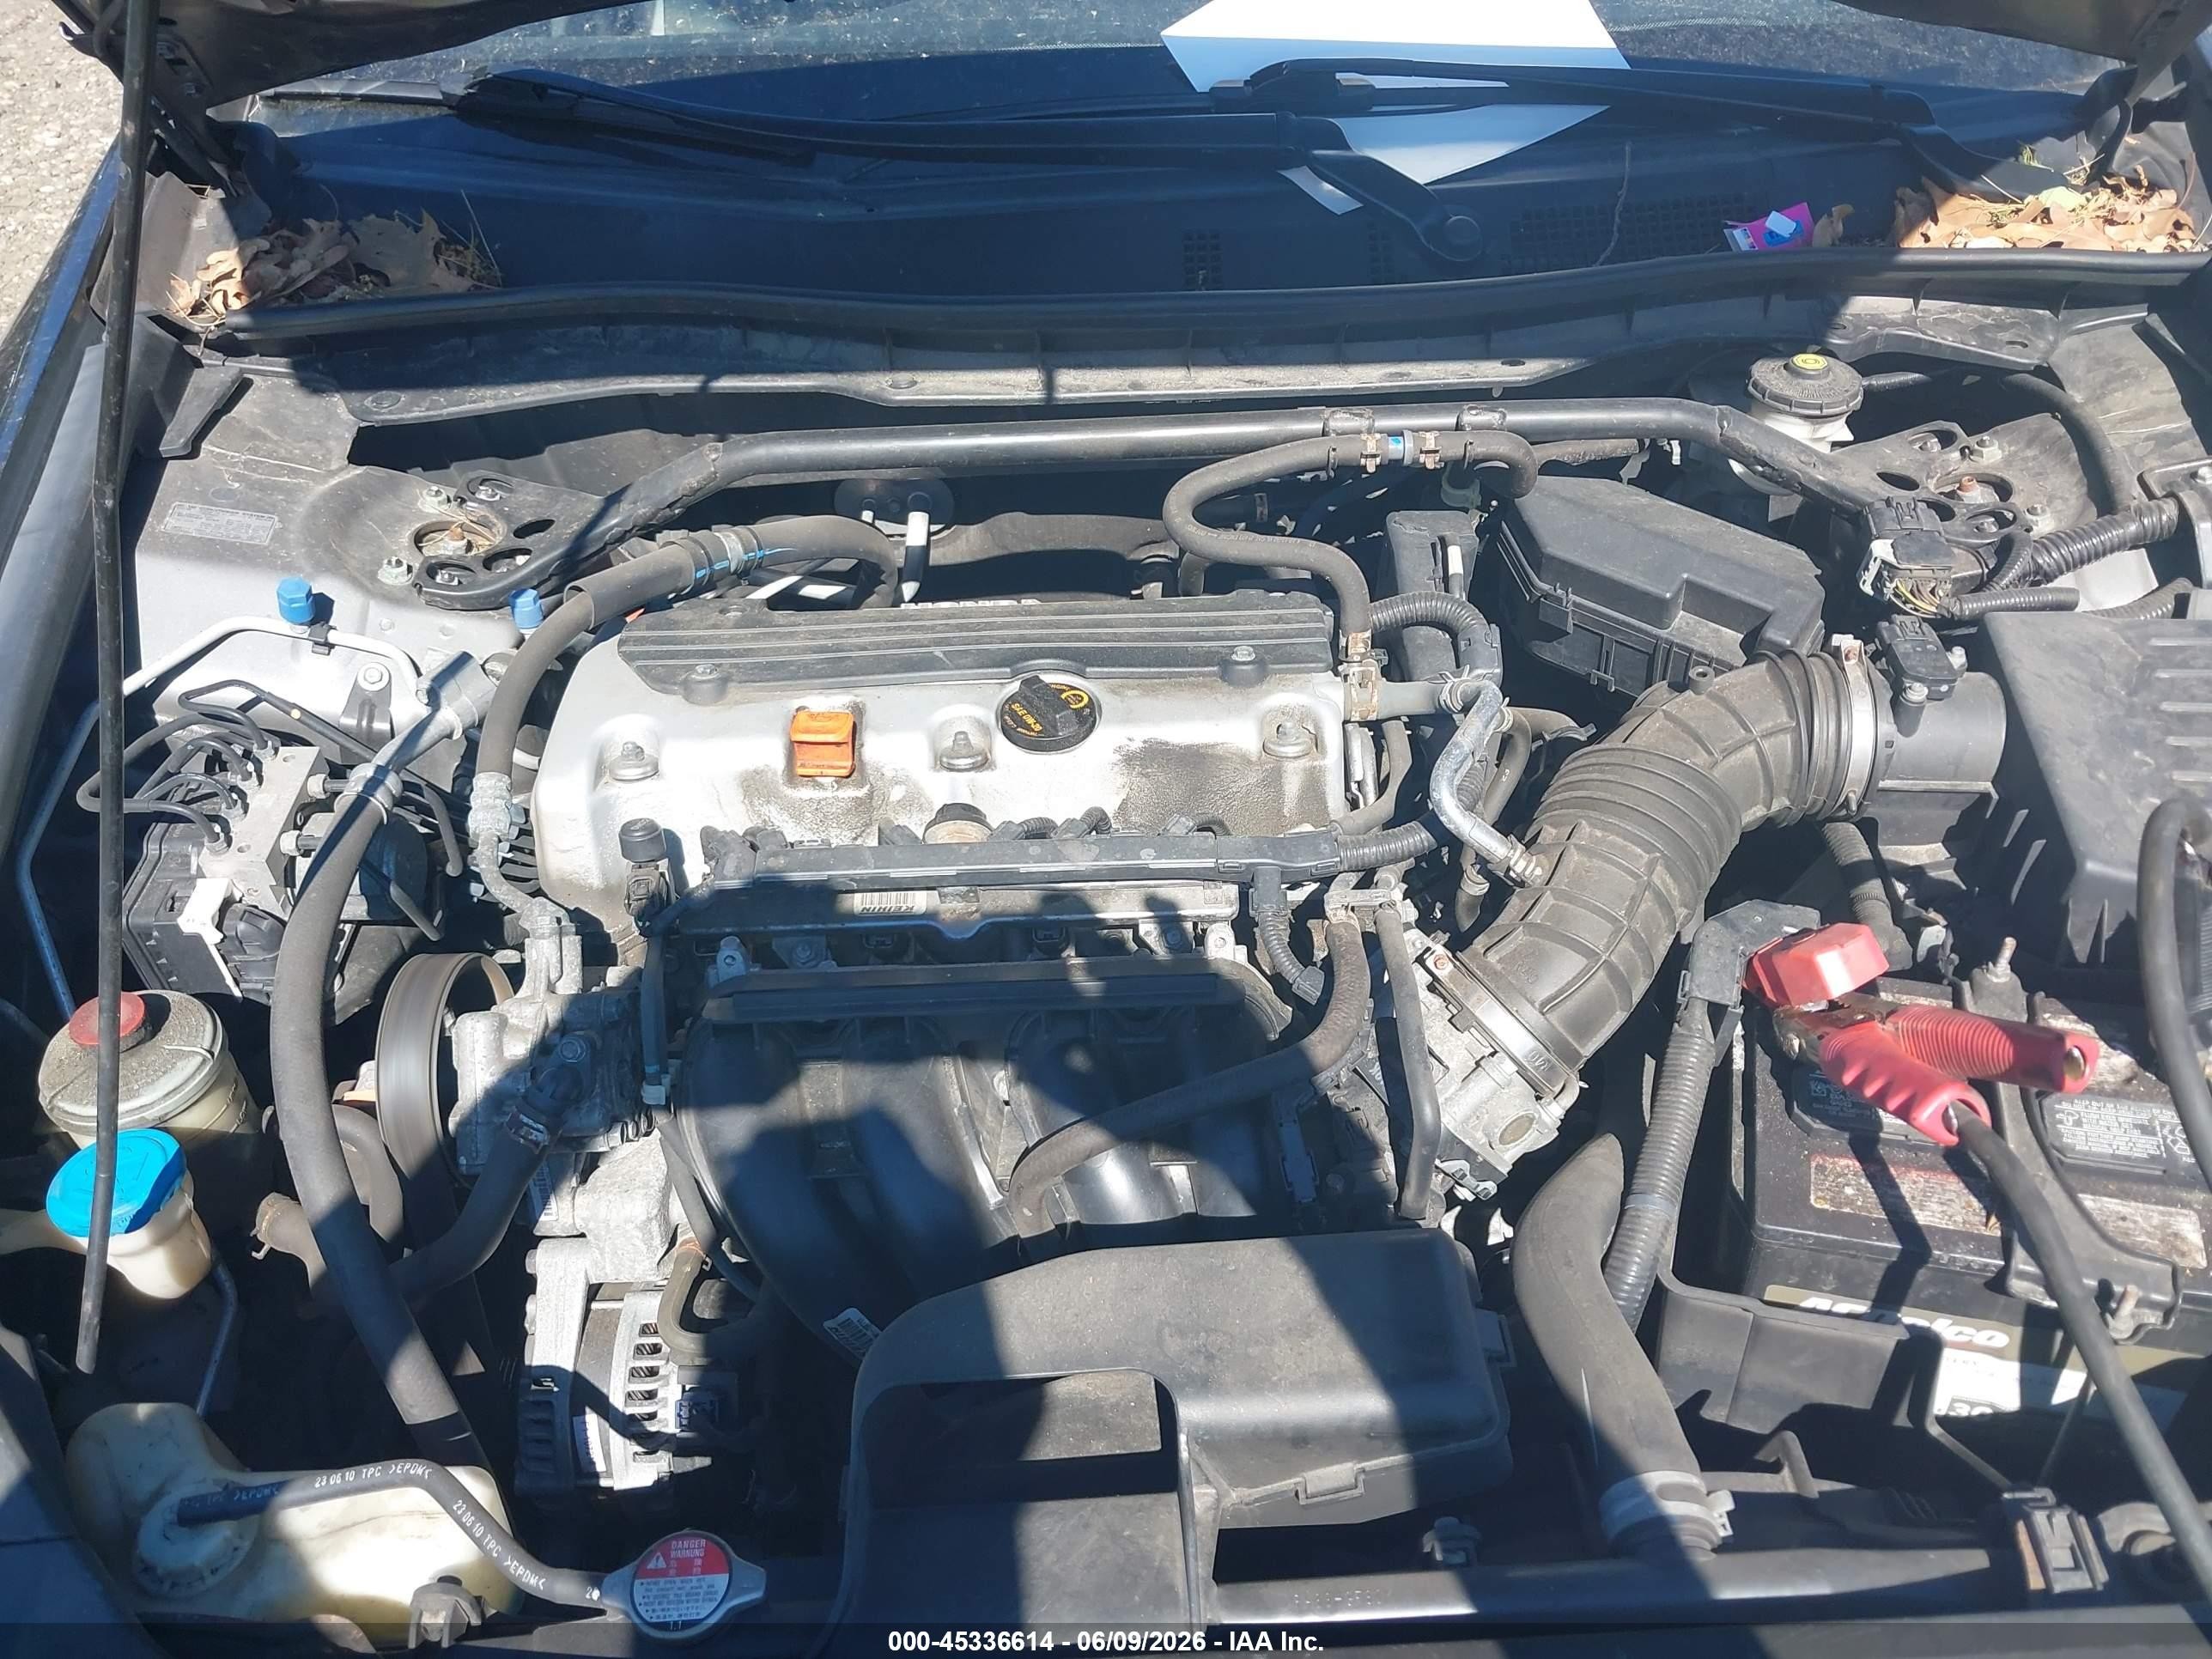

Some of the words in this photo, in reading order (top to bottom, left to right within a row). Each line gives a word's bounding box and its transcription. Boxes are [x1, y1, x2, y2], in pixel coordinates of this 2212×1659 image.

[1012, 702, 1028, 720] SAE
[315, 1476, 327, 1487] 23
[330, 1474, 342, 1485] 06
[345, 1470, 356, 1481] 10
[362, 1466, 381, 1479] TPC
[453, 1499, 466, 1515] 23
[462, 1511, 473, 1527] 06
[473, 1522, 484, 1538] 10
[483, 1534, 501, 1558] TPC
[672, 1539, 706, 1549] DANGER
[670, 1549, 705, 1559] WARNUNG
